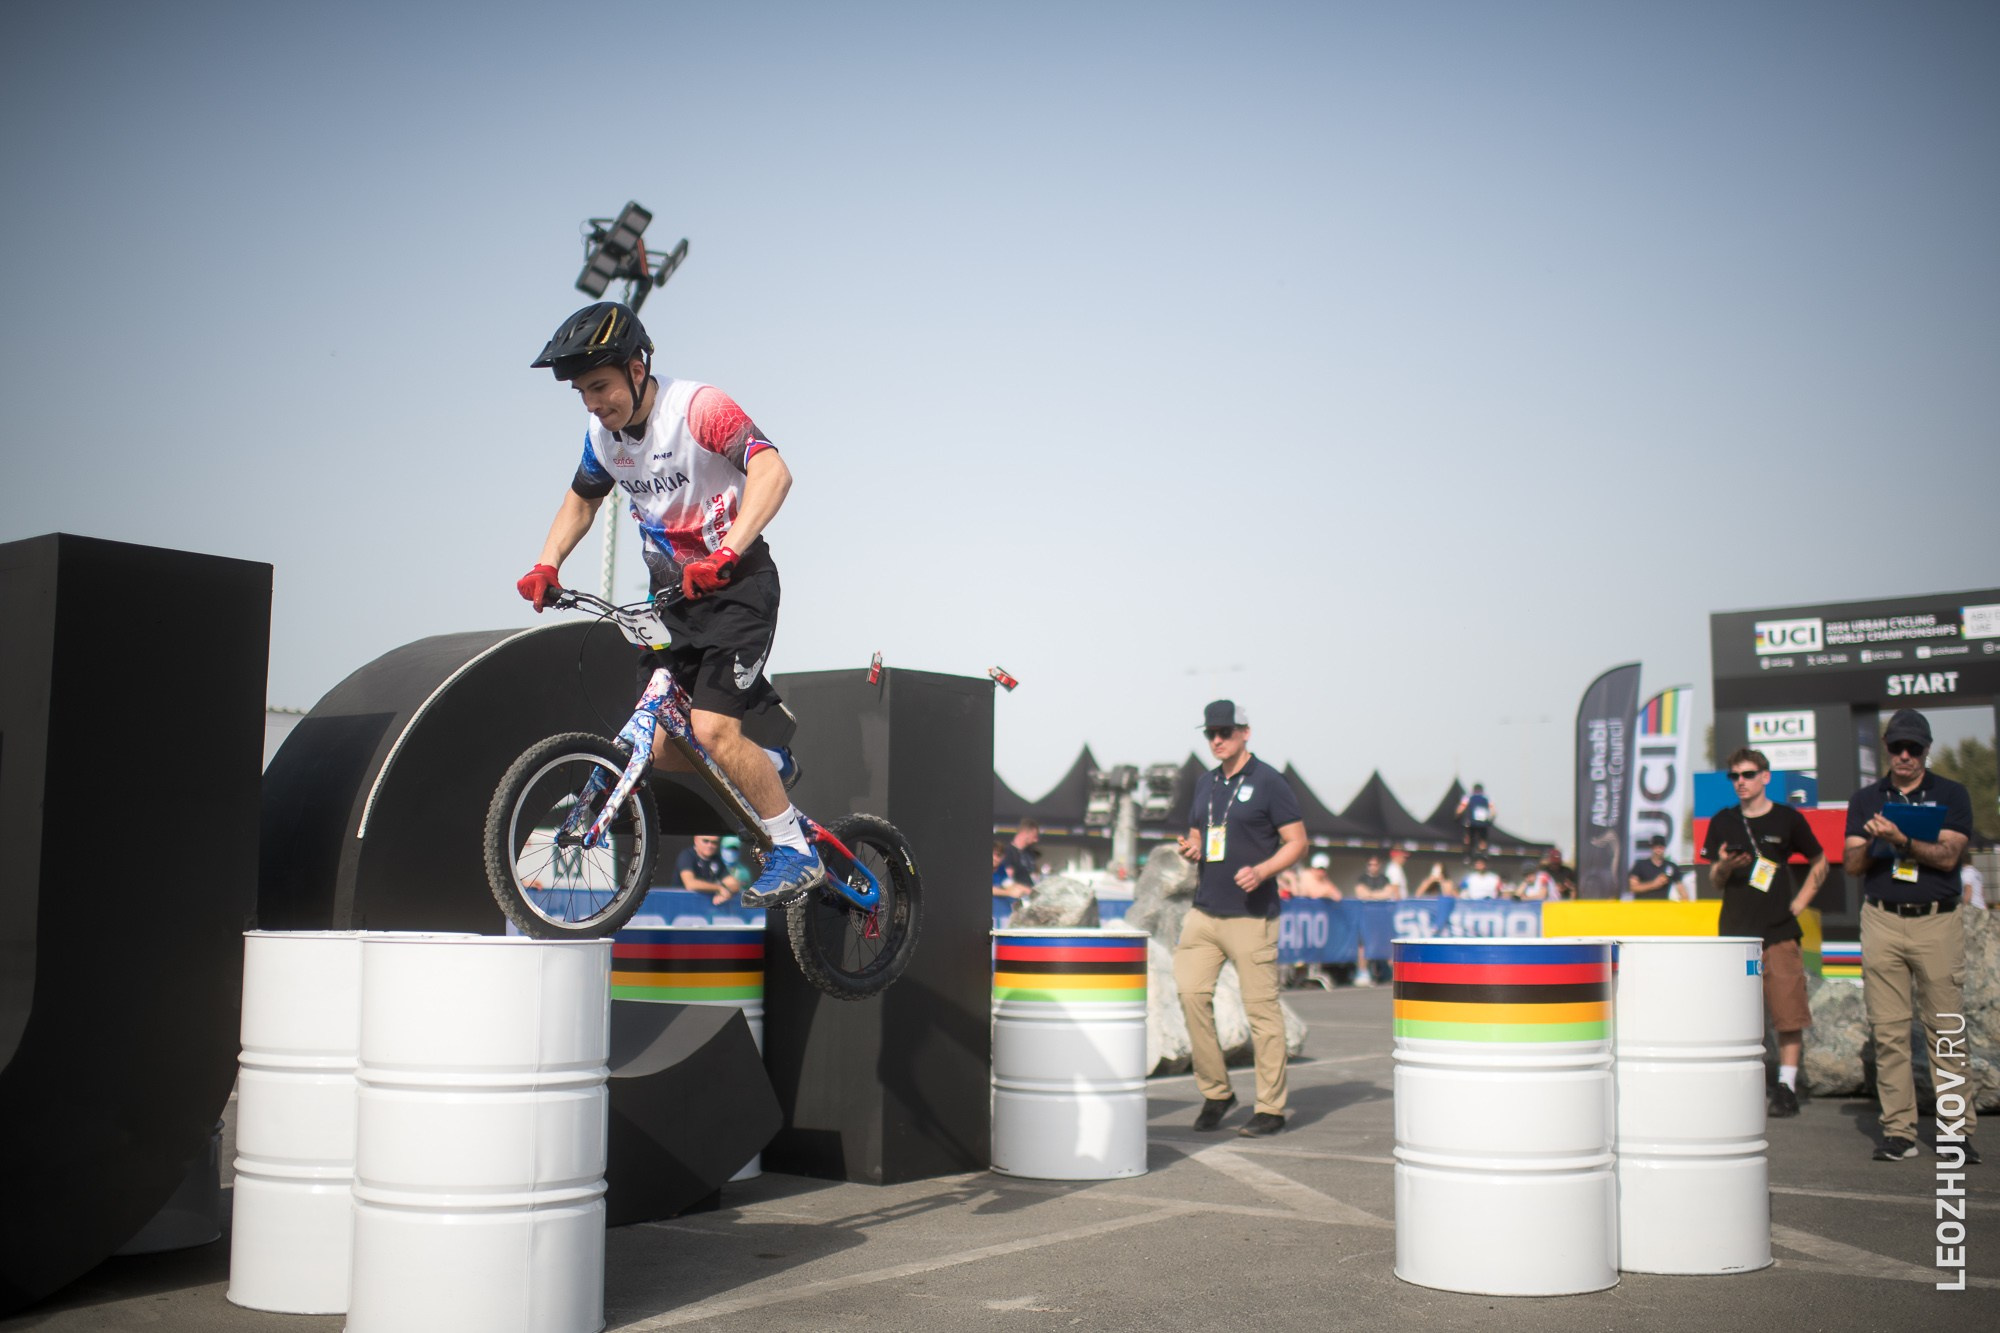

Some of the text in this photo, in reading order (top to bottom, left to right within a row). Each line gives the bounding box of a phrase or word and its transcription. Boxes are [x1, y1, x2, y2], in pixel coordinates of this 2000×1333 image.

[620, 472, 690, 494] SLOVAKIA
[711, 494, 728, 547] STRABA
[1826, 624, 1957, 645] WORLD CHAMPIONSHIPS
[1851, 618, 1887, 632] URBAN
[1889, 614, 1936, 629] CYCLING
[1768, 627, 1816, 646] UCI
[1887, 671, 1959, 696] START
[1764, 719, 1804, 735] UCI
[1607, 717, 1624, 775] Council
[1588, 719, 1607, 827] Abu Dhabi
[1636, 746, 1677, 850] UCI
[1279, 911, 1329, 950] ANO
